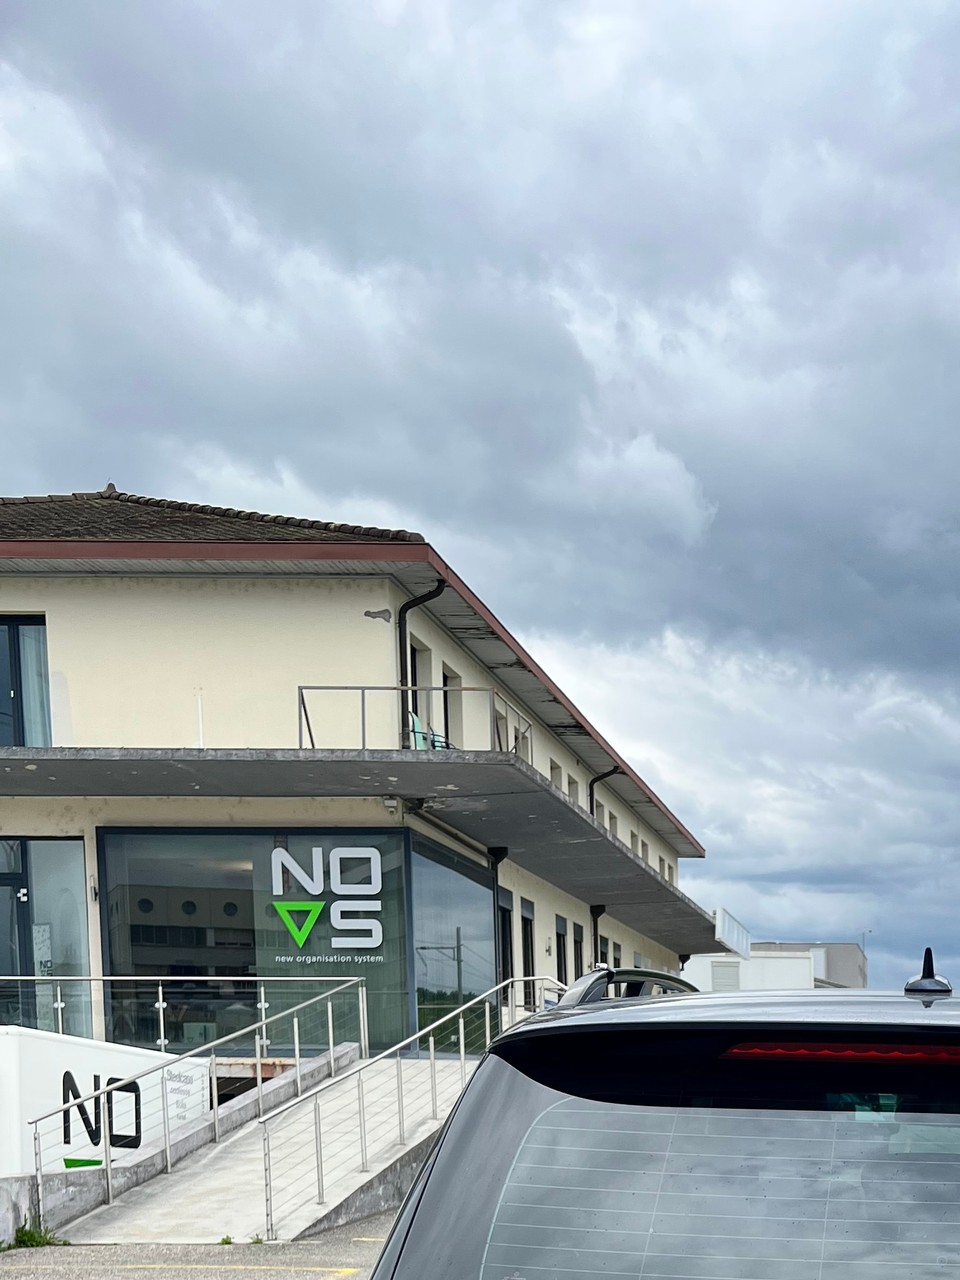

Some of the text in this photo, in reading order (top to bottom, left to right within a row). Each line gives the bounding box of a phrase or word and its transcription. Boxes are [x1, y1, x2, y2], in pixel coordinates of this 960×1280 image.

[271, 847, 382, 896] NO
[275, 953, 384, 965] new organisation system
